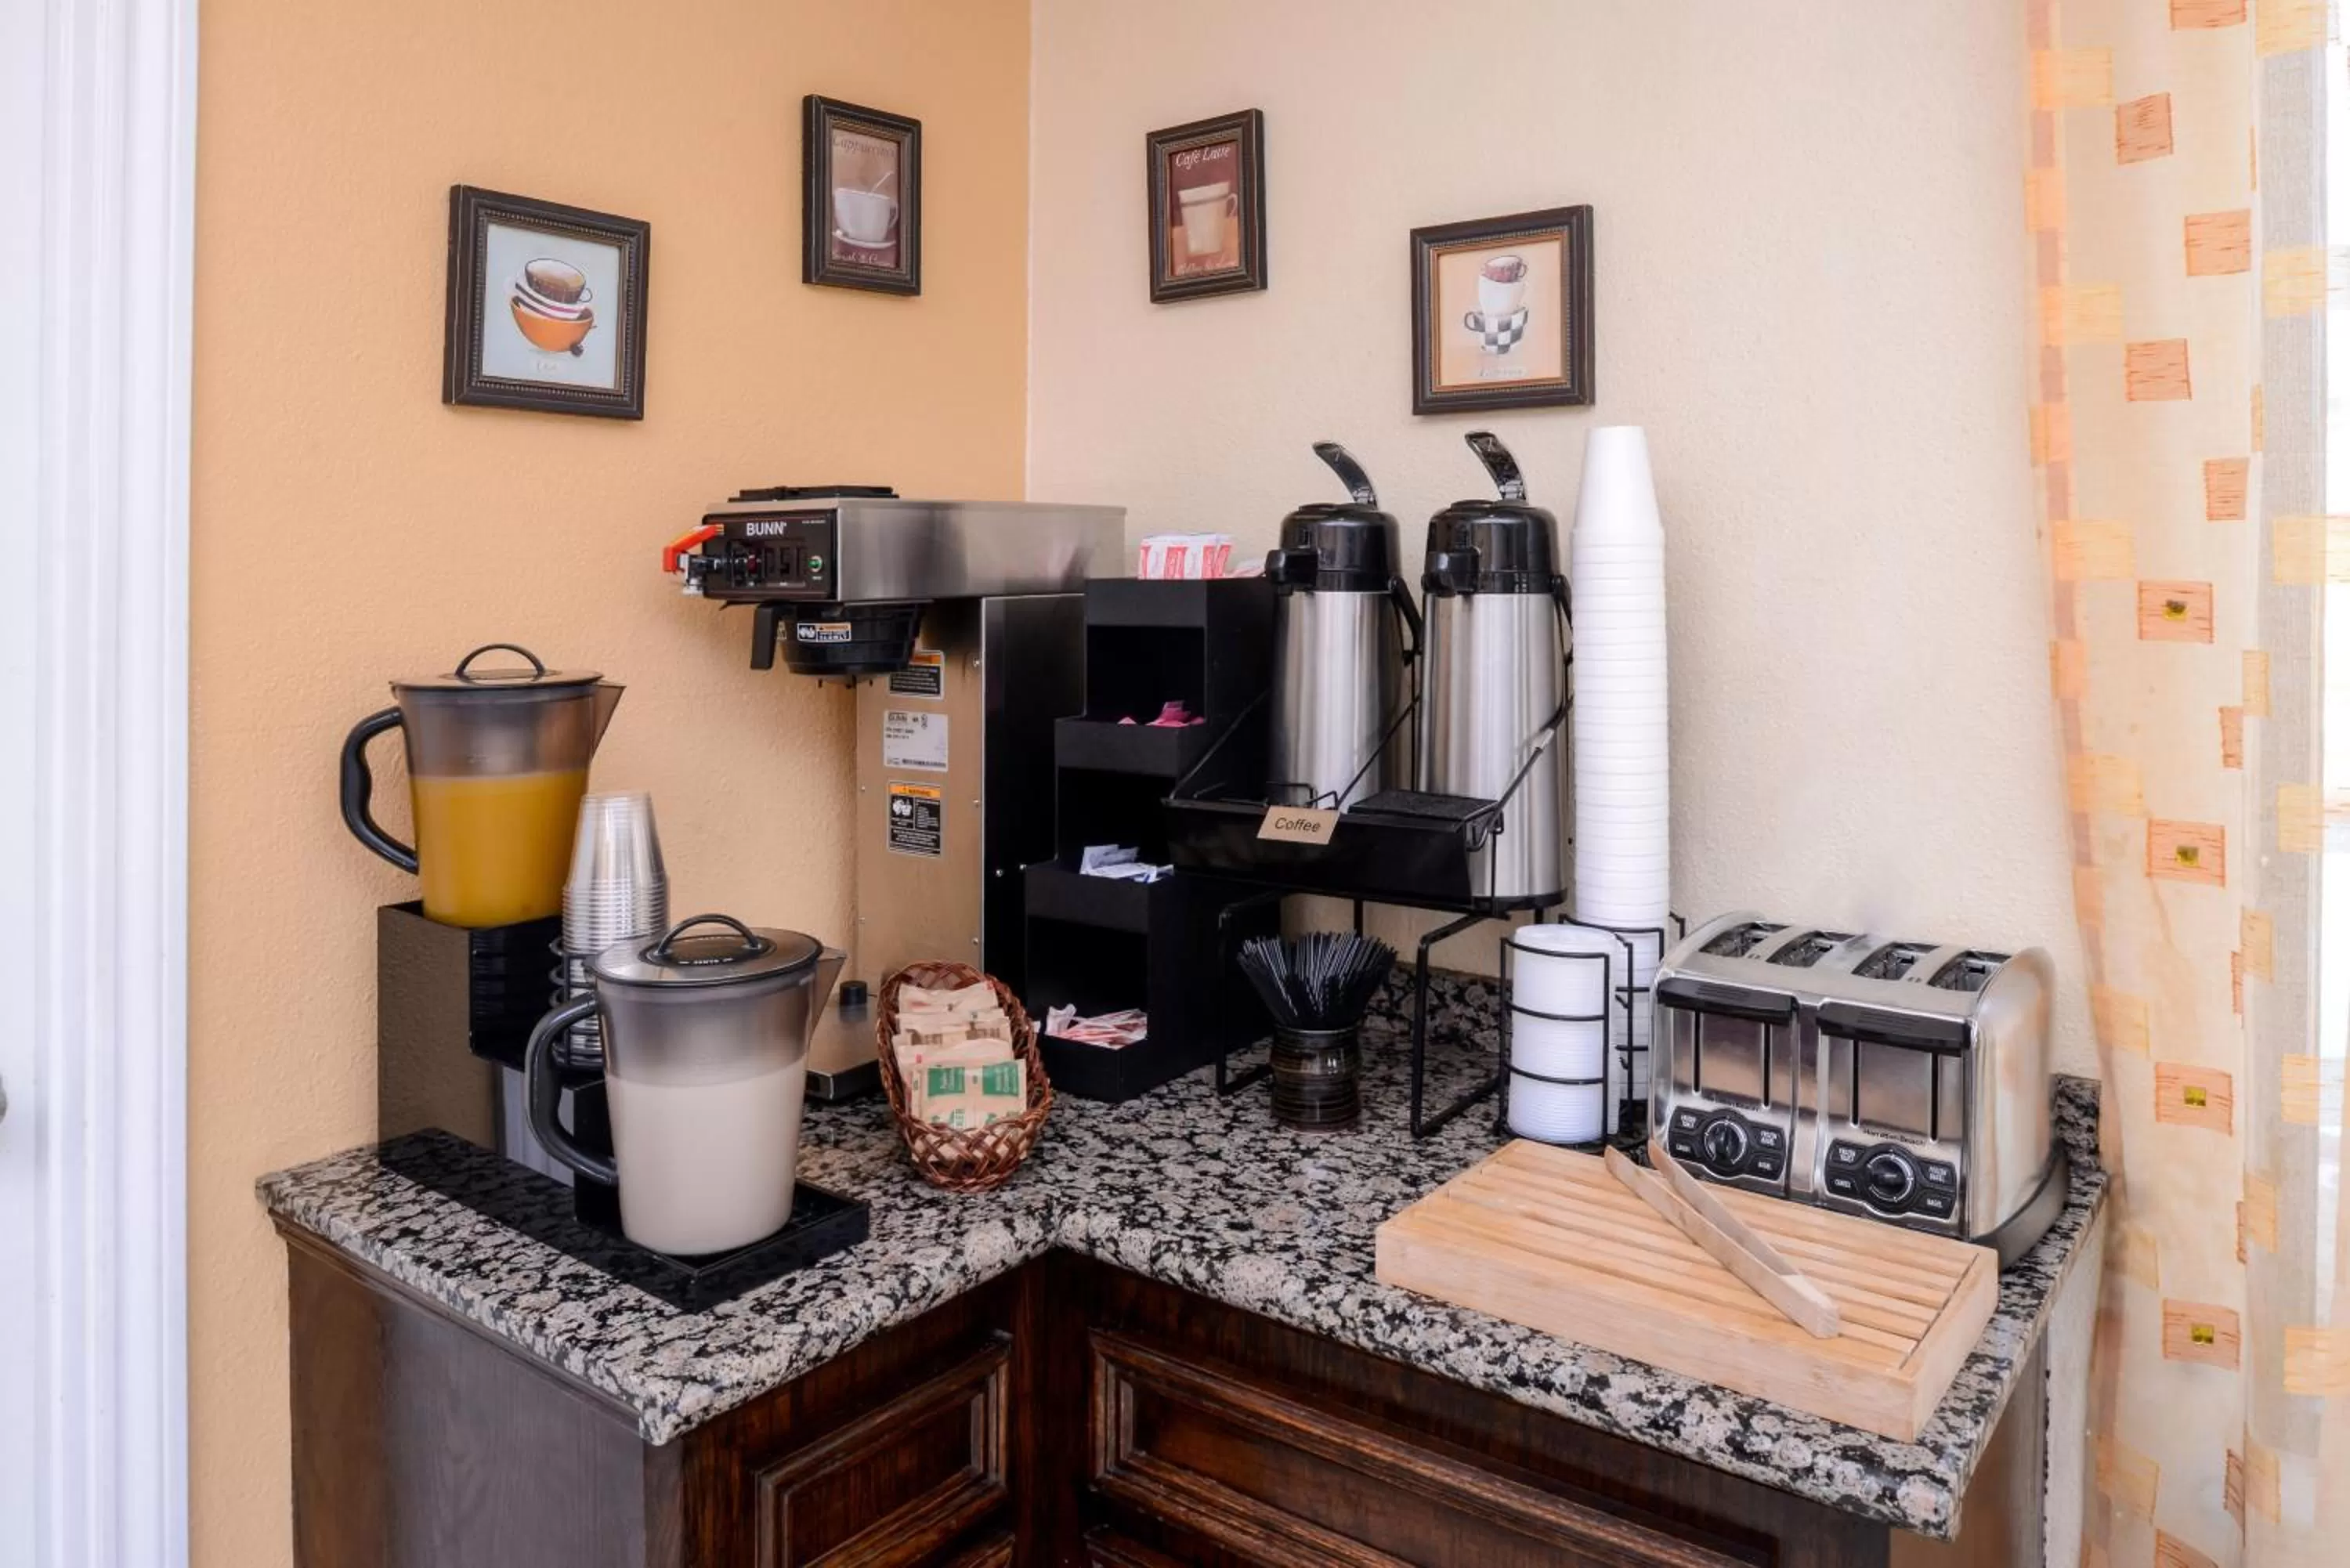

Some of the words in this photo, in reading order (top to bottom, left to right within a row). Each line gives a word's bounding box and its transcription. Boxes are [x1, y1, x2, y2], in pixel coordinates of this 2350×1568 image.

[1202, 146, 1231, 161] Latte
[746, 521, 786, 537] BUNN
[1274, 817, 1321, 833] Coffee
